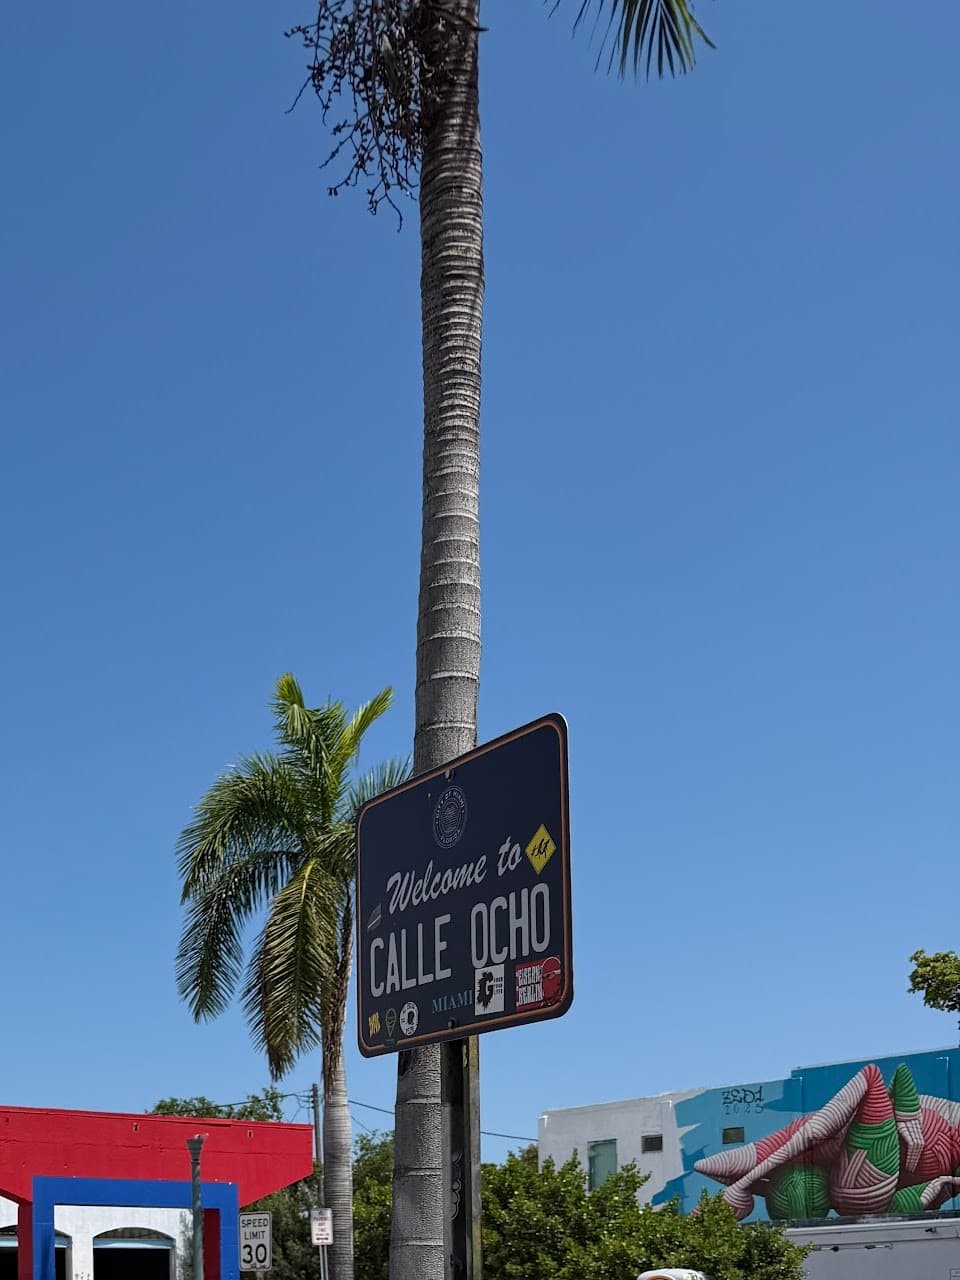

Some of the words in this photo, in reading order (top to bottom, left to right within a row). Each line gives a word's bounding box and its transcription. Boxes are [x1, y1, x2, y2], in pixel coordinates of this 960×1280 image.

[386, 855, 487, 915] Welcome
[497, 836, 522, 877] to
[370, 913, 451, 998] CALLE
[471, 883, 550, 969] OCHO
[431, 989, 474, 1014] MIAMI
[241, 1218, 269, 1228] SPEED
[244, 1231, 266, 1240] LIMIT
[242, 1243, 267, 1264] 30
